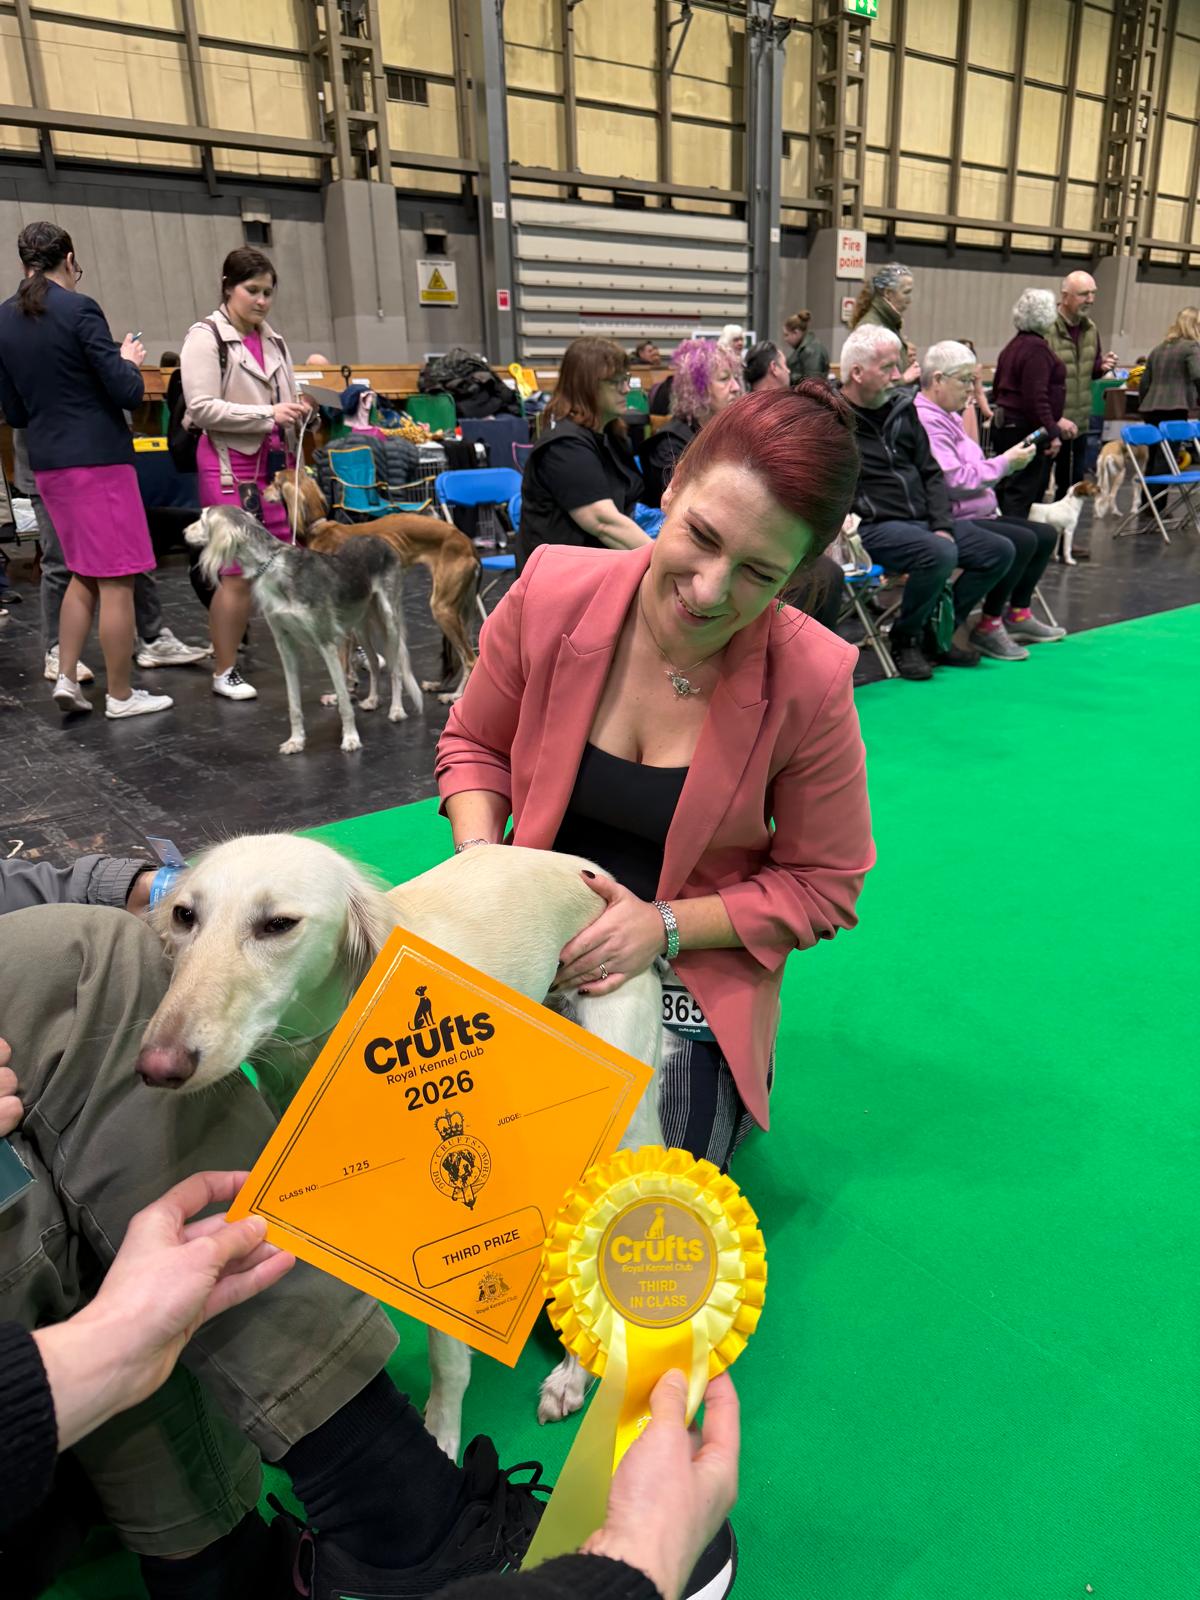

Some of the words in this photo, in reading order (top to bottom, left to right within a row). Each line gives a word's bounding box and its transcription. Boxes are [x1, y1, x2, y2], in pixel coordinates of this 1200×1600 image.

[842, 236, 861, 251] Fire
[839, 256, 864, 270] point
[364, 1012, 495, 1075] Crufts
[386, 1067, 417, 1085] Royal
[419, 1054, 457, 1074] Kennel
[459, 1046, 484, 1061] Club
[404, 1070, 474, 1111] 2026
[497, 1112, 522, 1126] JUDGE:
[436, 1137, 478, 1158] CRUFTS
[342, 1160, 370, 1176] 1725
[432, 1170, 445, 1190] DOG
[480, 1151, 490, 1179] SHOW
[279, 1188, 304, 1202] CLASS
[305, 1184, 319, 1193] NO:
[442, 1244, 481, 1265] THIRD
[484, 1229, 520, 1250] PRIZE
[610, 1234, 705, 1263] Crufts
[622, 1265, 644, 1275] Royal
[645, 1263, 673, 1273] Kennel
[675, 1263, 693, 1272] Club
[639, 1280, 678, 1293] THIRD
[630, 1296, 643, 1308] IN
[646, 1295, 688, 1308] CLASS
